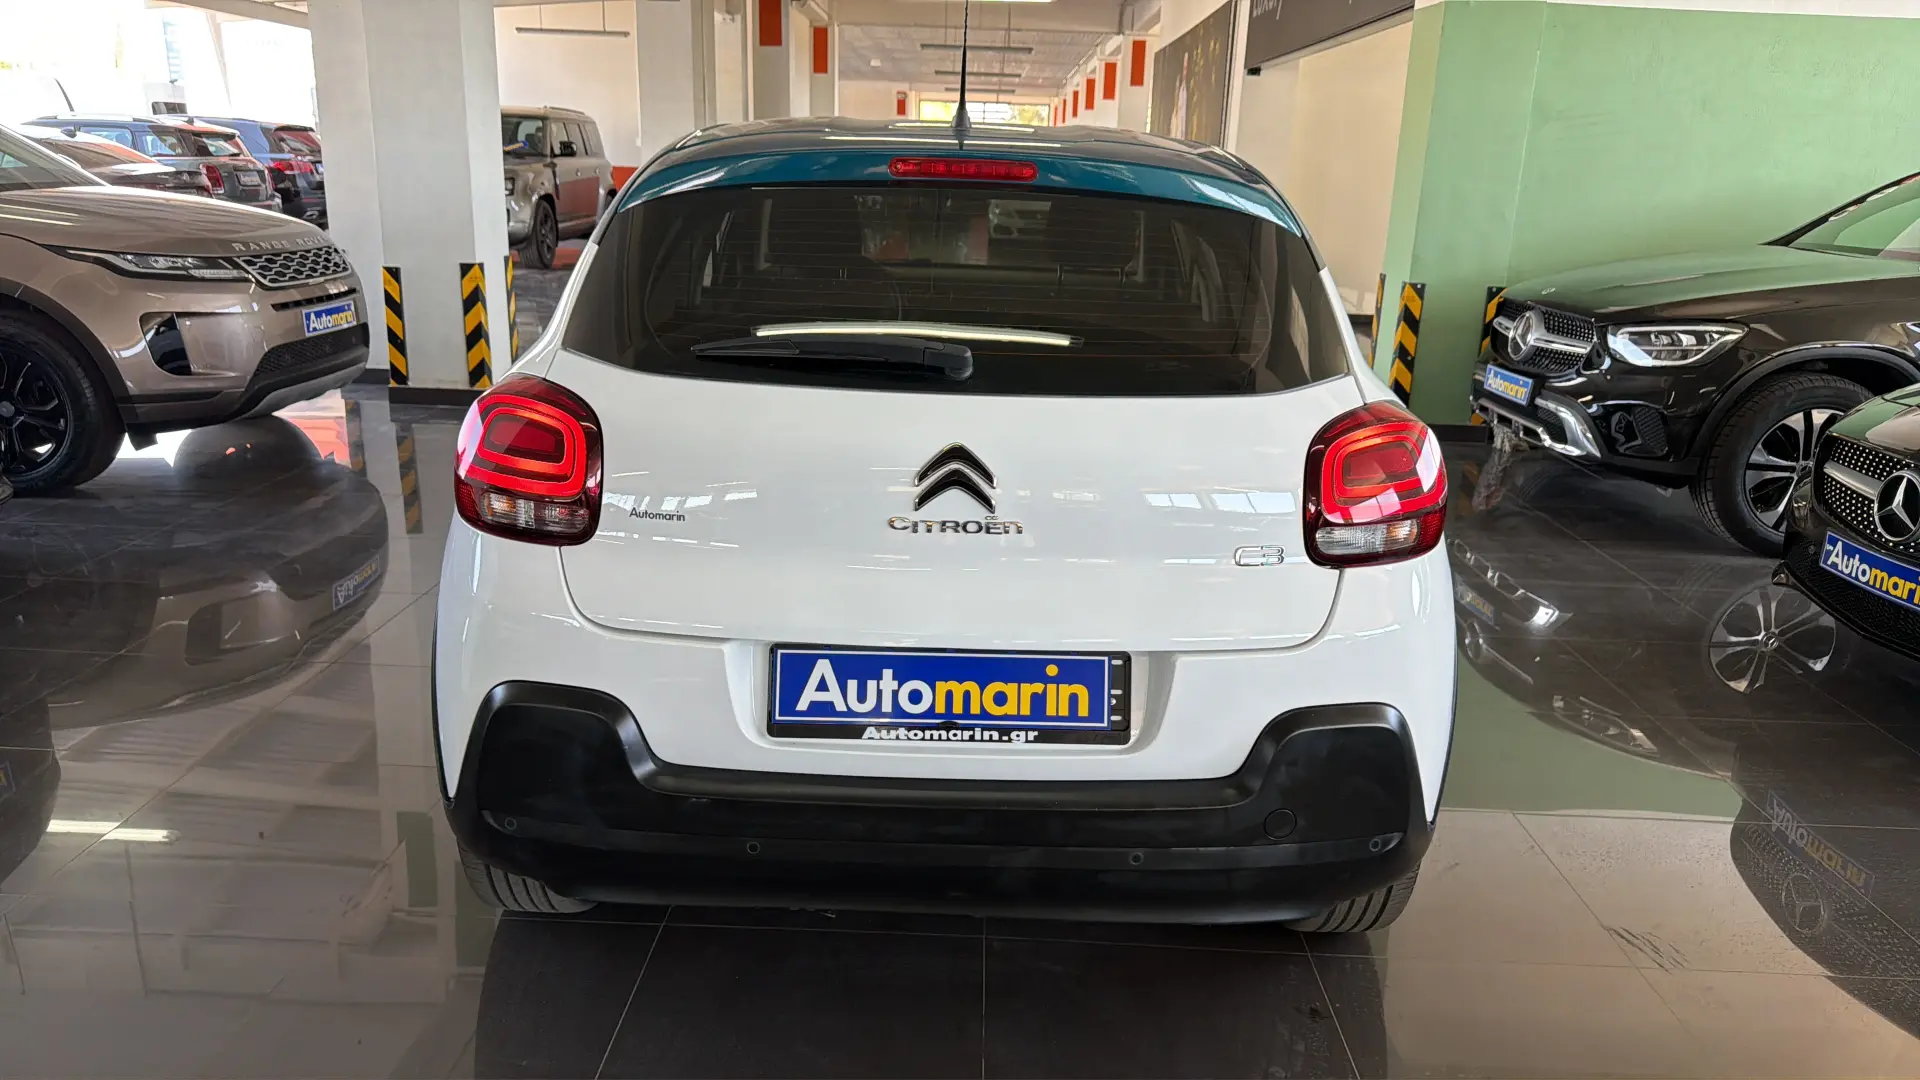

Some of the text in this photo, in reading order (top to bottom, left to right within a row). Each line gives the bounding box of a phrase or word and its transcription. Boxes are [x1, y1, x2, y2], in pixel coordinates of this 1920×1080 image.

[231, 240, 290, 251] RANGE
[309, 305, 353, 331] Automarin
[1487, 369, 1527, 400] Automarin
[628, 506, 686, 522] Automarin
[1234, 545, 1286, 567] C3
[1826, 540, 1920, 605] Automari
[795, 658, 1090, 718] Automarin
[861, 726, 1039, 744] Automarin.gr
